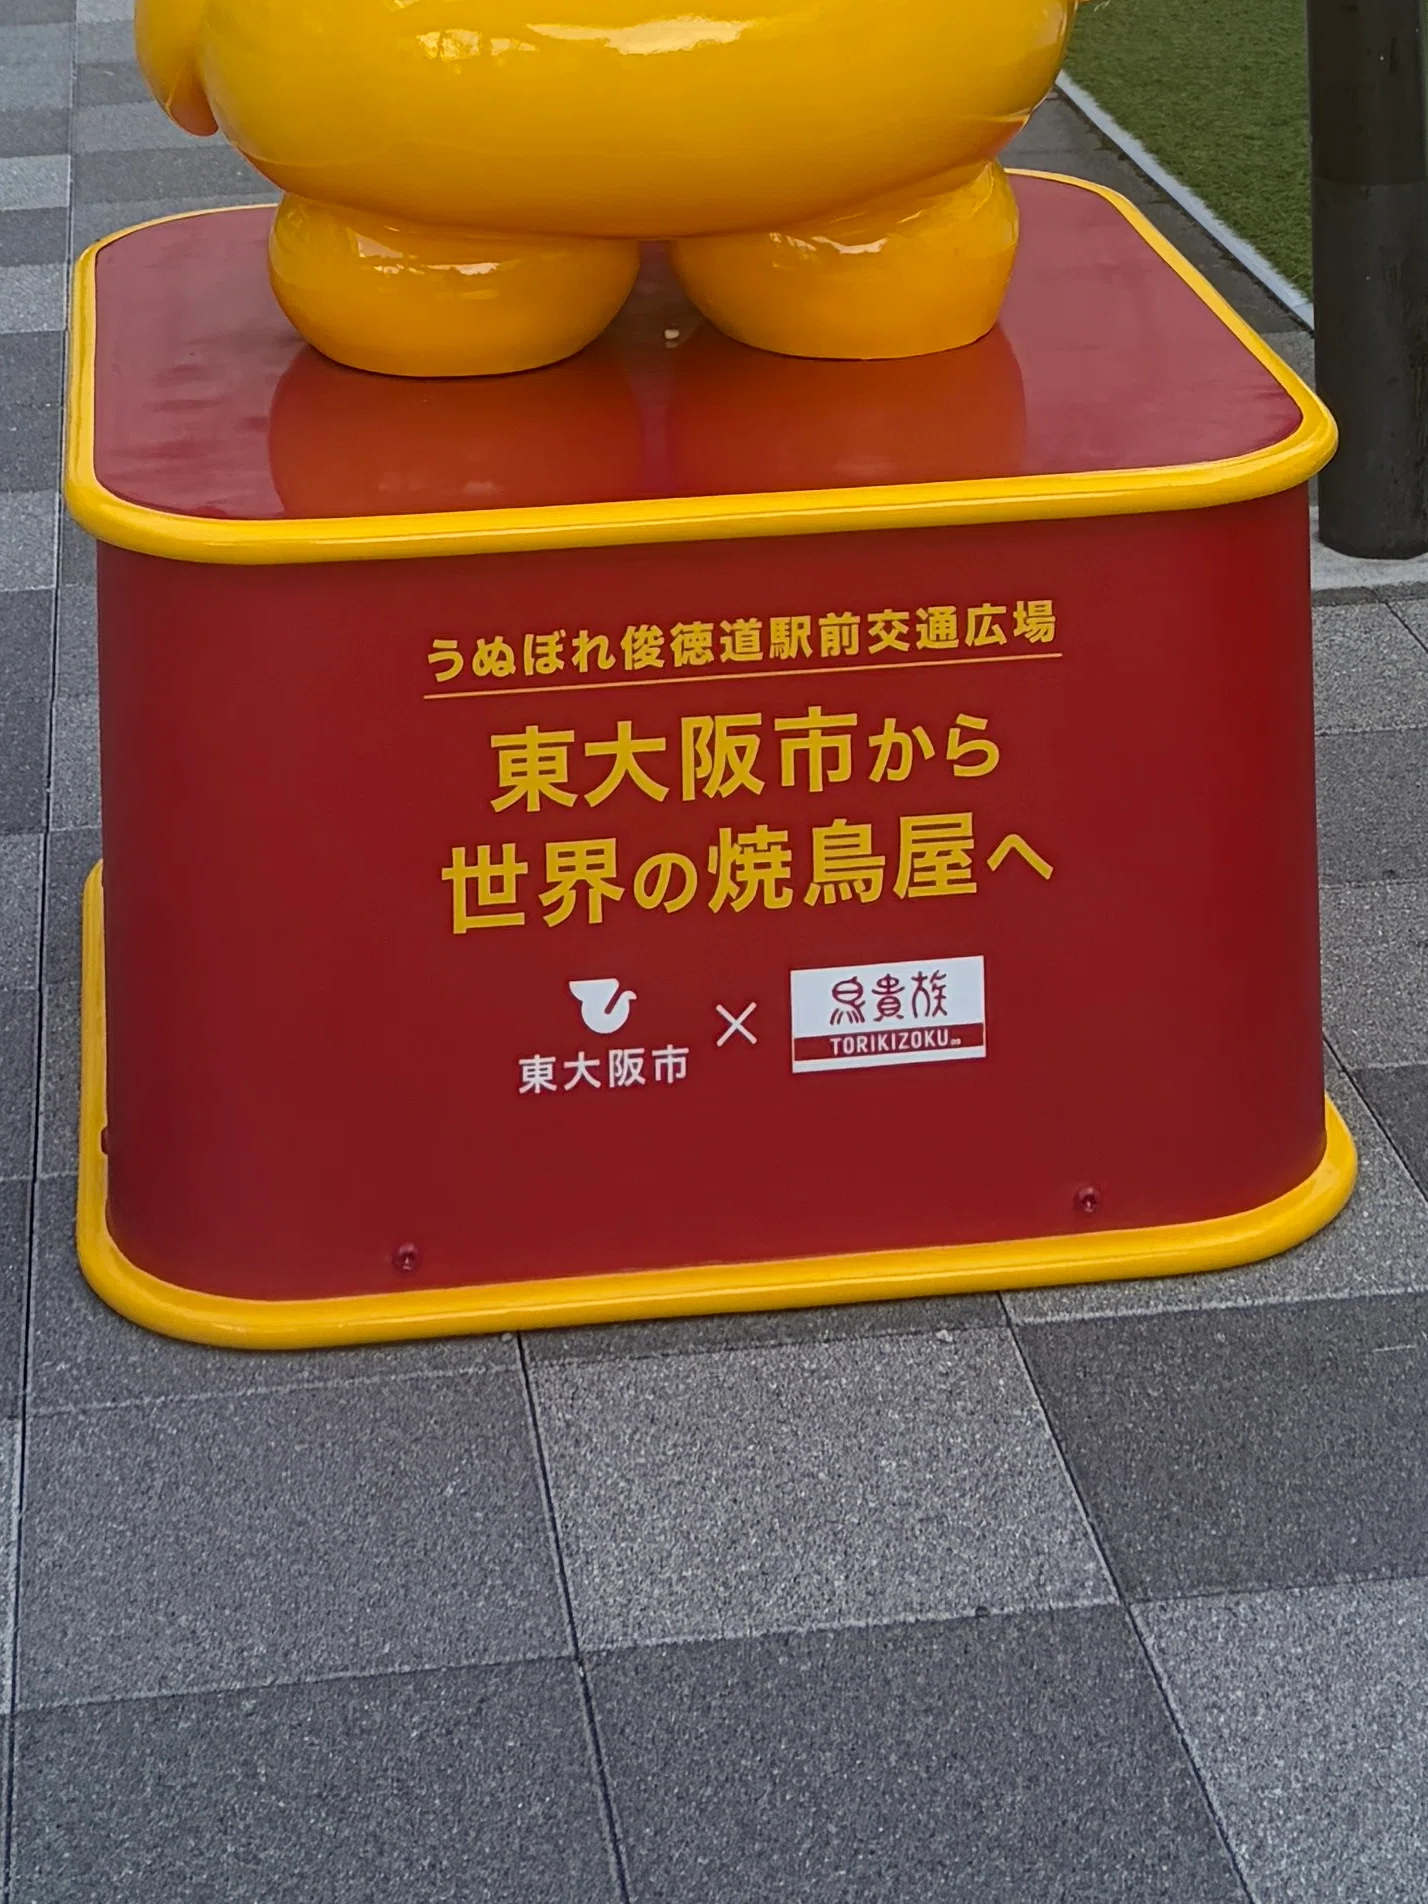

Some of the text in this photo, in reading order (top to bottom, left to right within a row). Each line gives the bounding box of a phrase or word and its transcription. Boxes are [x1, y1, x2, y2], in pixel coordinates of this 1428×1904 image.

[426, 598, 1058, 683] うぬぼれ俊徳道駅前交通広場
[489, 704, 1001, 814] 東大阪市から
[440, 810, 1055, 934] 世界の焼鳥屋へ
[517, 1043, 691, 1095] 東大阪市
[829, 1028, 949, 1056] TORIKIZOKU
